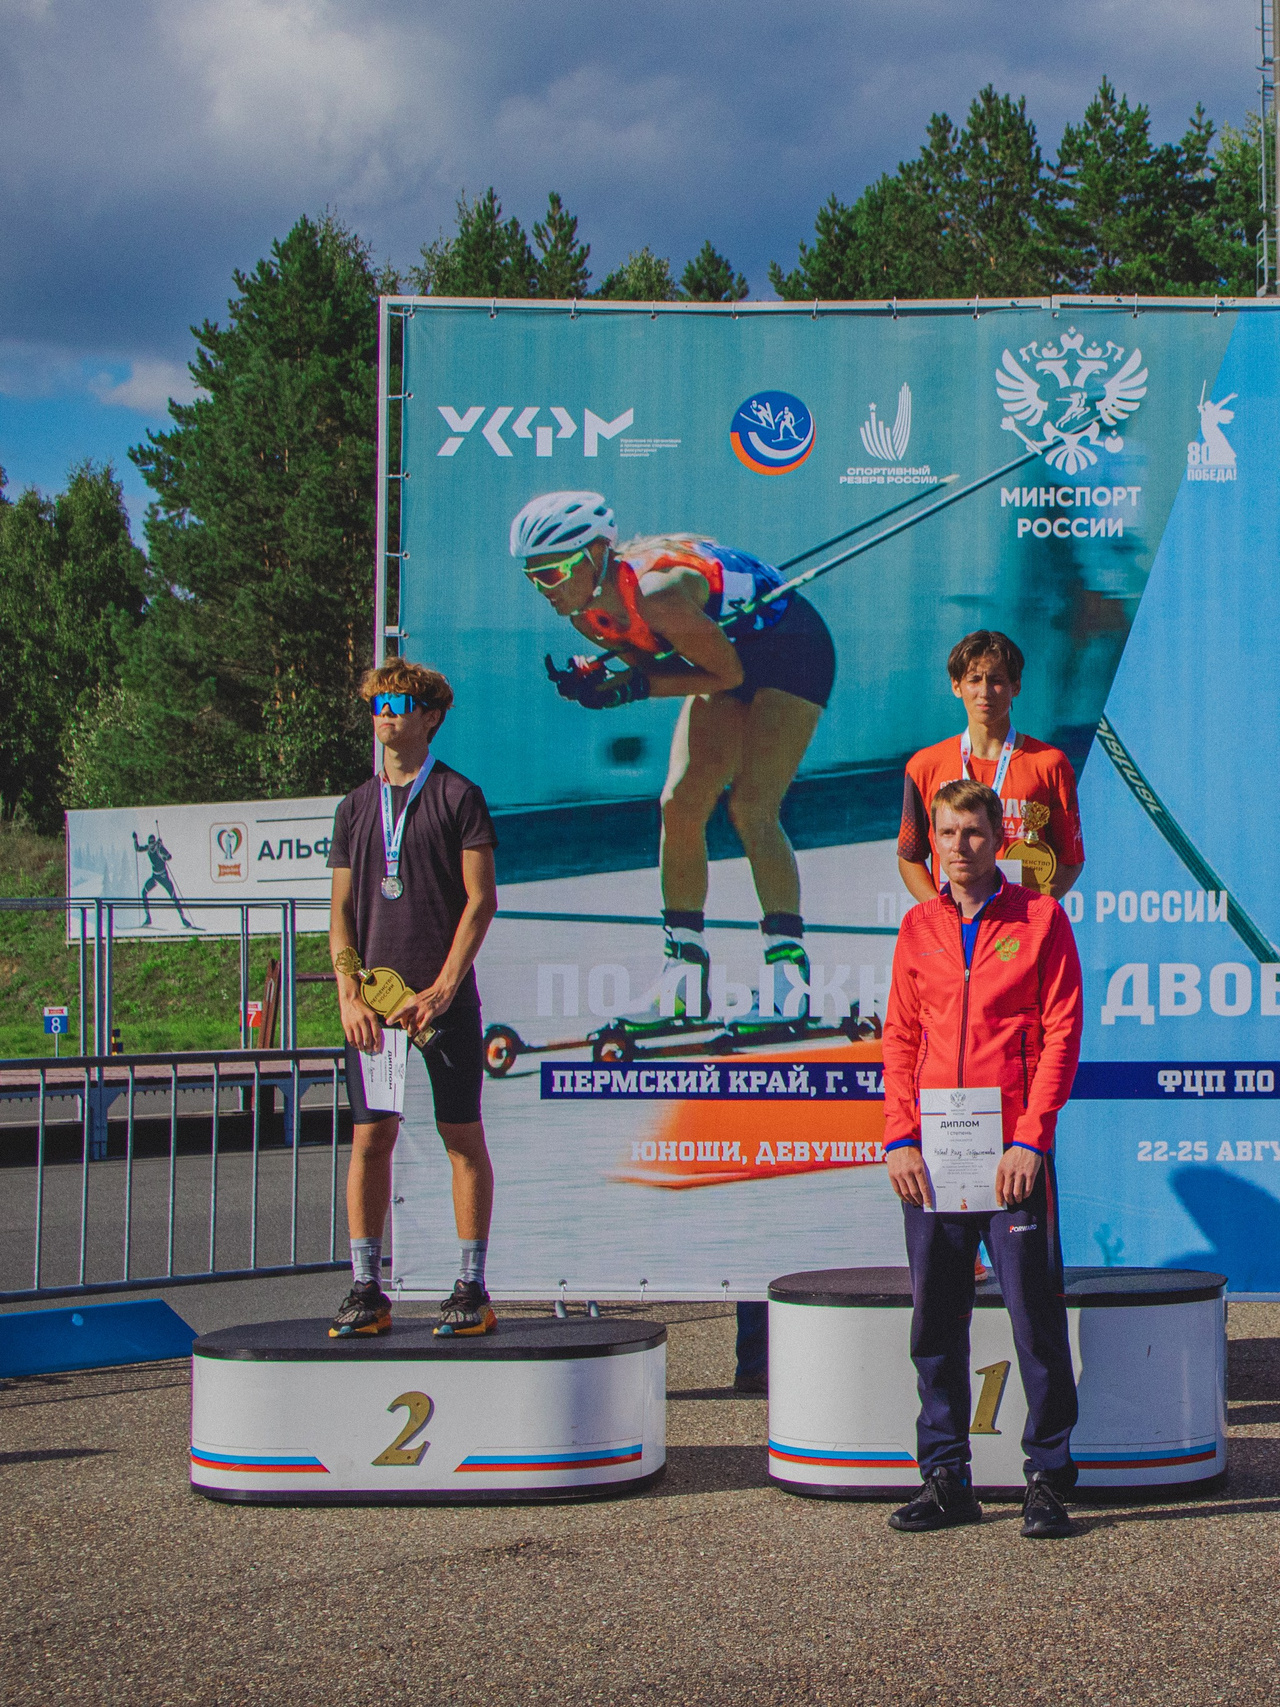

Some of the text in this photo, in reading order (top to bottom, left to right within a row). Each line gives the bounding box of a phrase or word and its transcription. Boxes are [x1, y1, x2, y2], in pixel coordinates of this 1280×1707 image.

[839, 476, 938, 484] РЕЗЕРВ РОССИИ
[846, 465, 931, 475] СПОРТИВНЫЙ
[1187, 468, 1237, 483] ПОБЕДА!
[1000, 486, 1142, 507] МИНСПОРТ
[1017, 517, 1123, 538] РОССИИ
[1096, 889, 1229, 923] РОССИИ
[370, 975, 395, 1005] ПЕРВЕНСТВО
[378, 984, 395, 1004] РОССИИ
[537, 963, 891, 1018] ПО ЛЫЖН
[51, 1017, 61, 1033] 8
[247, 1011, 257, 1027] 7
[552, 1064, 720, 1094] ПЕРМСКИЙ
[728, 1064, 817, 1097] КРАЙ,
[825, 1070, 848, 1094] Г.
[1157, 1069, 1226, 1096] ФЦП
[1234, 1069, 1275, 1093] ПО
[940, 1120, 980, 1129] ДИПЛОМ
[631, 1140, 888, 1165] ЮНОШИ, ДЕВУШКИ
[1137, 1140, 1209, 1162] 22-25
[969, 1360, 1011, 1435] 1
[370, 1390, 435, 1467] 2
